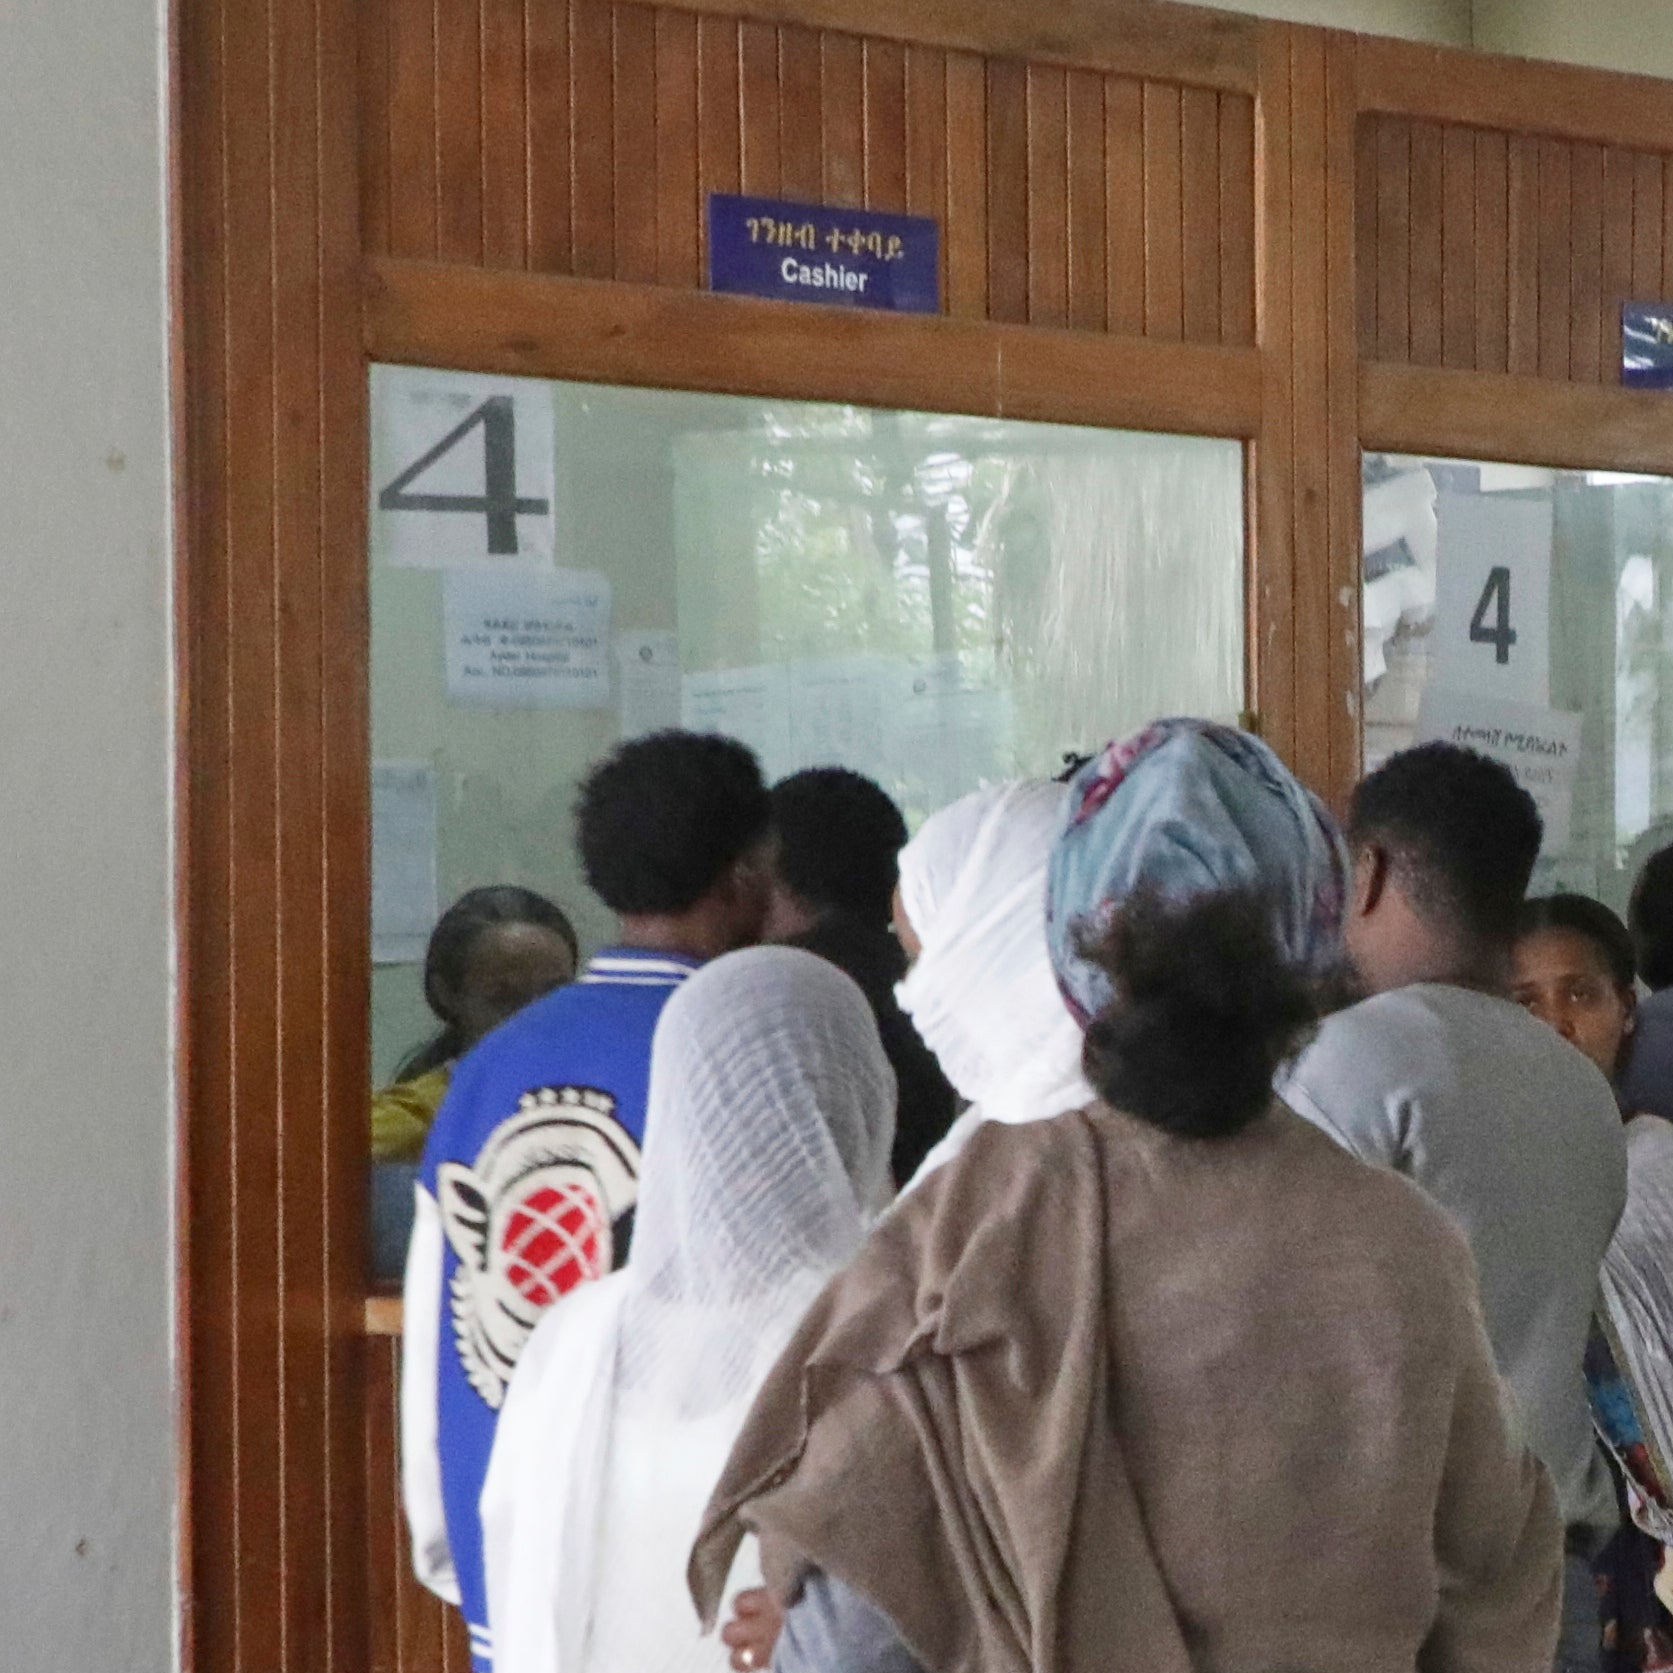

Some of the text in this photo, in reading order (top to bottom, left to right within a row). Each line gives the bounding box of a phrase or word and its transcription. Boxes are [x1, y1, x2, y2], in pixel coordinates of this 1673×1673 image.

[780, 257, 869, 293] Cashier
[380, 395, 549, 554] 4
[1469, 566, 1517, 664] 4
